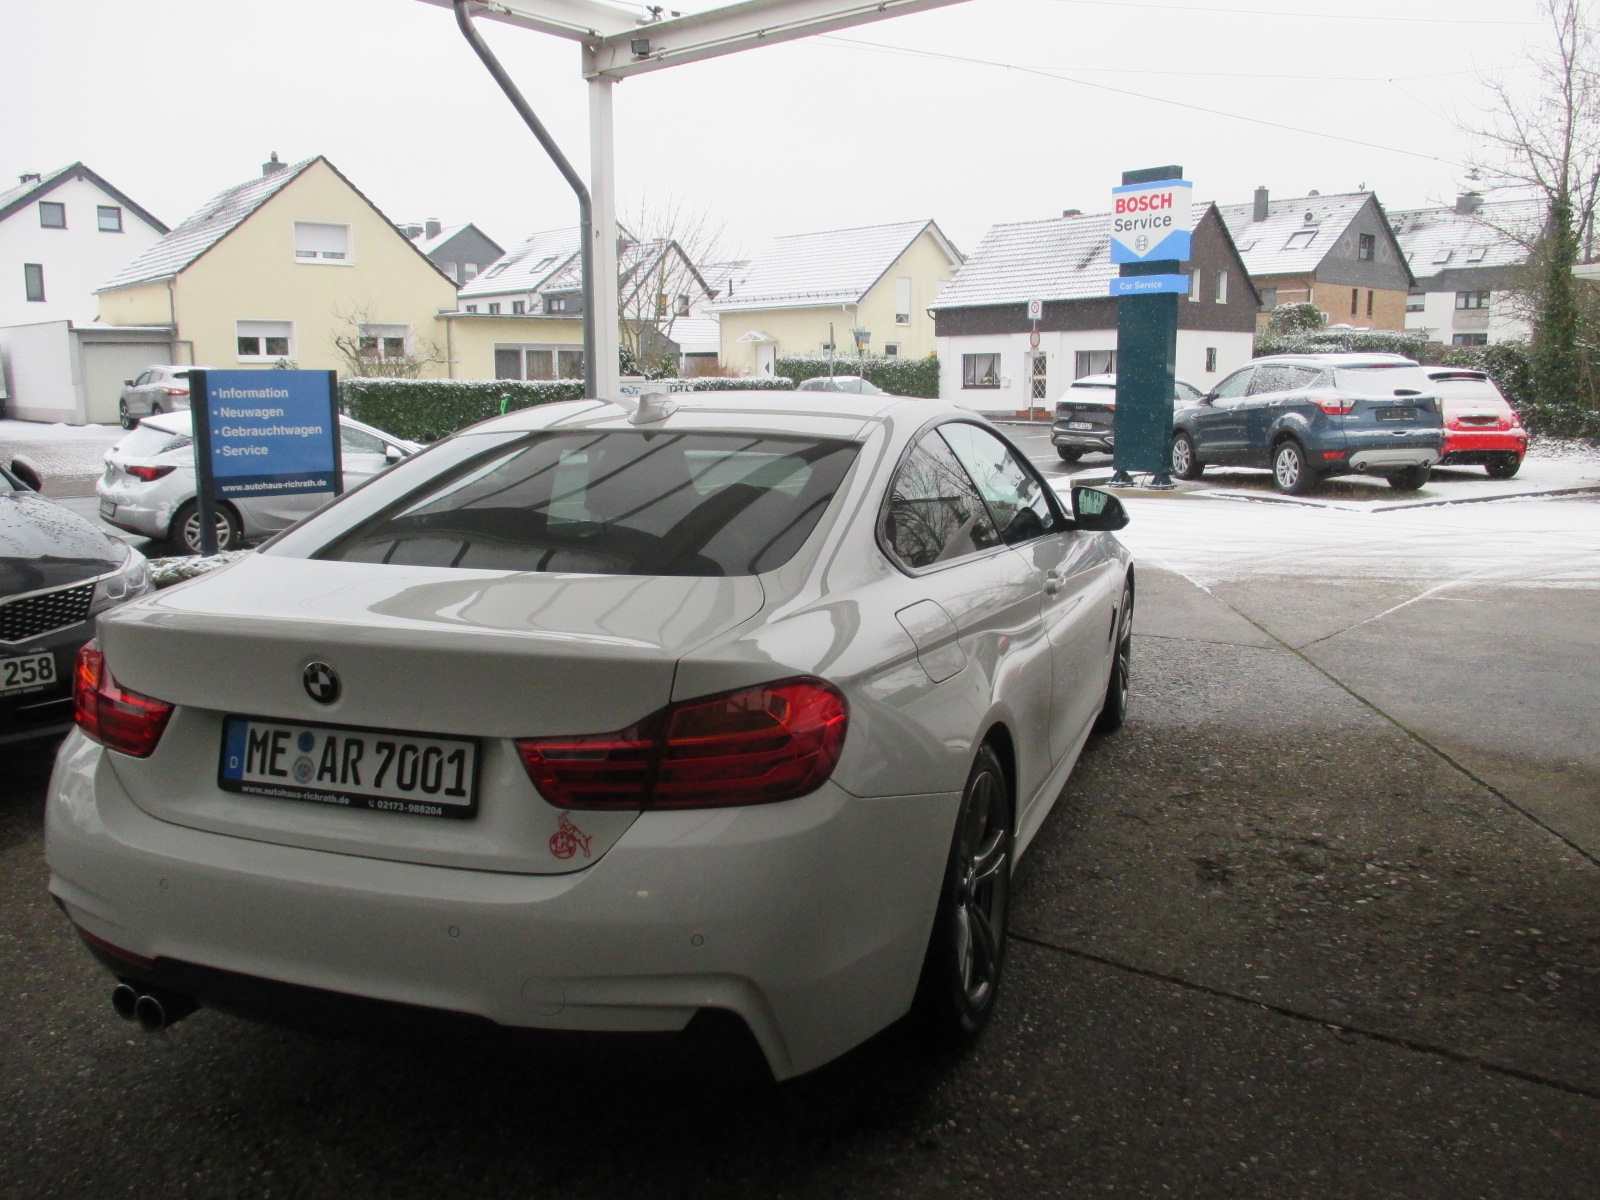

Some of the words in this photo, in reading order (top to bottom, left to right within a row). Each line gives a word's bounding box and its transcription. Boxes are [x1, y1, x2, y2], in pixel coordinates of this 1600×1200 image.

[1115, 192, 1173, 214] BOSCH
[1114, 213, 1172, 233] Service
[1119, 281, 1133, 290] Car
[1134, 281, 1163, 289] Service
[218, 387, 289, 399] Information
[220, 407, 284, 420] Neuwagen
[221, 425, 322, 438] Gebrauchtwagen
[222, 445, 269, 456] Service
[222, 479, 327, 492] www.autohaus-richrath.de
[4, 657, 53, 687] 258
[229, 755, 238, 769] D
[246, 728, 292, 777] ME
[316, 736, 365, 786] AR
[373, 740, 467, 798] 7001
[241, 784, 350, 805] www.autohaus-richrath.de
[377, 799, 443, 816] 02173-988204
